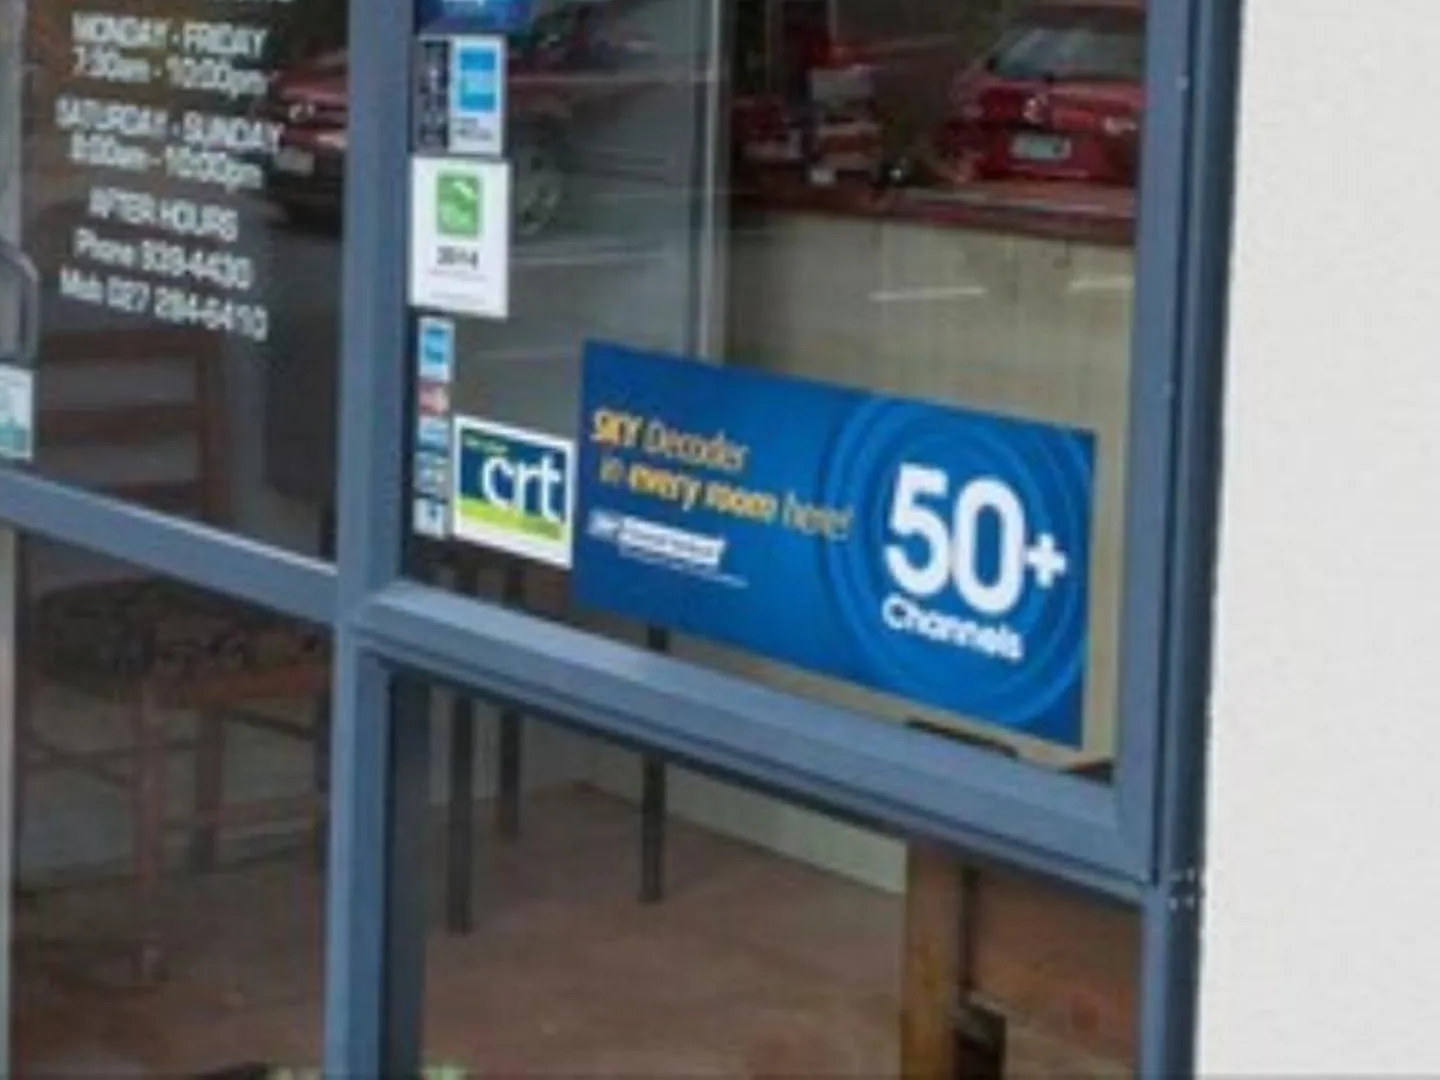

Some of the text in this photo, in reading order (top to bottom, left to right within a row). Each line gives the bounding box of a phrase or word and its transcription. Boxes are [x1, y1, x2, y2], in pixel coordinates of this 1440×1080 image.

[71, 12, 169, 49] MONDAY
[183, 21, 268, 58] FRIDAY
[55, 95, 168, 136] SATURDAY
[183, 109, 284, 153] SUNDAY
[89, 186, 239, 242] AFTER HOURS
[74, 227, 135, 267] Phone
[643, 418, 749, 474] Decoder
[482, 455, 565, 526] crt
[629, 464, 702, 512] every
[706, 480, 777, 524] room
[884, 463, 1067, 615] 50+
[881, 593, 1025, 661] Channels
